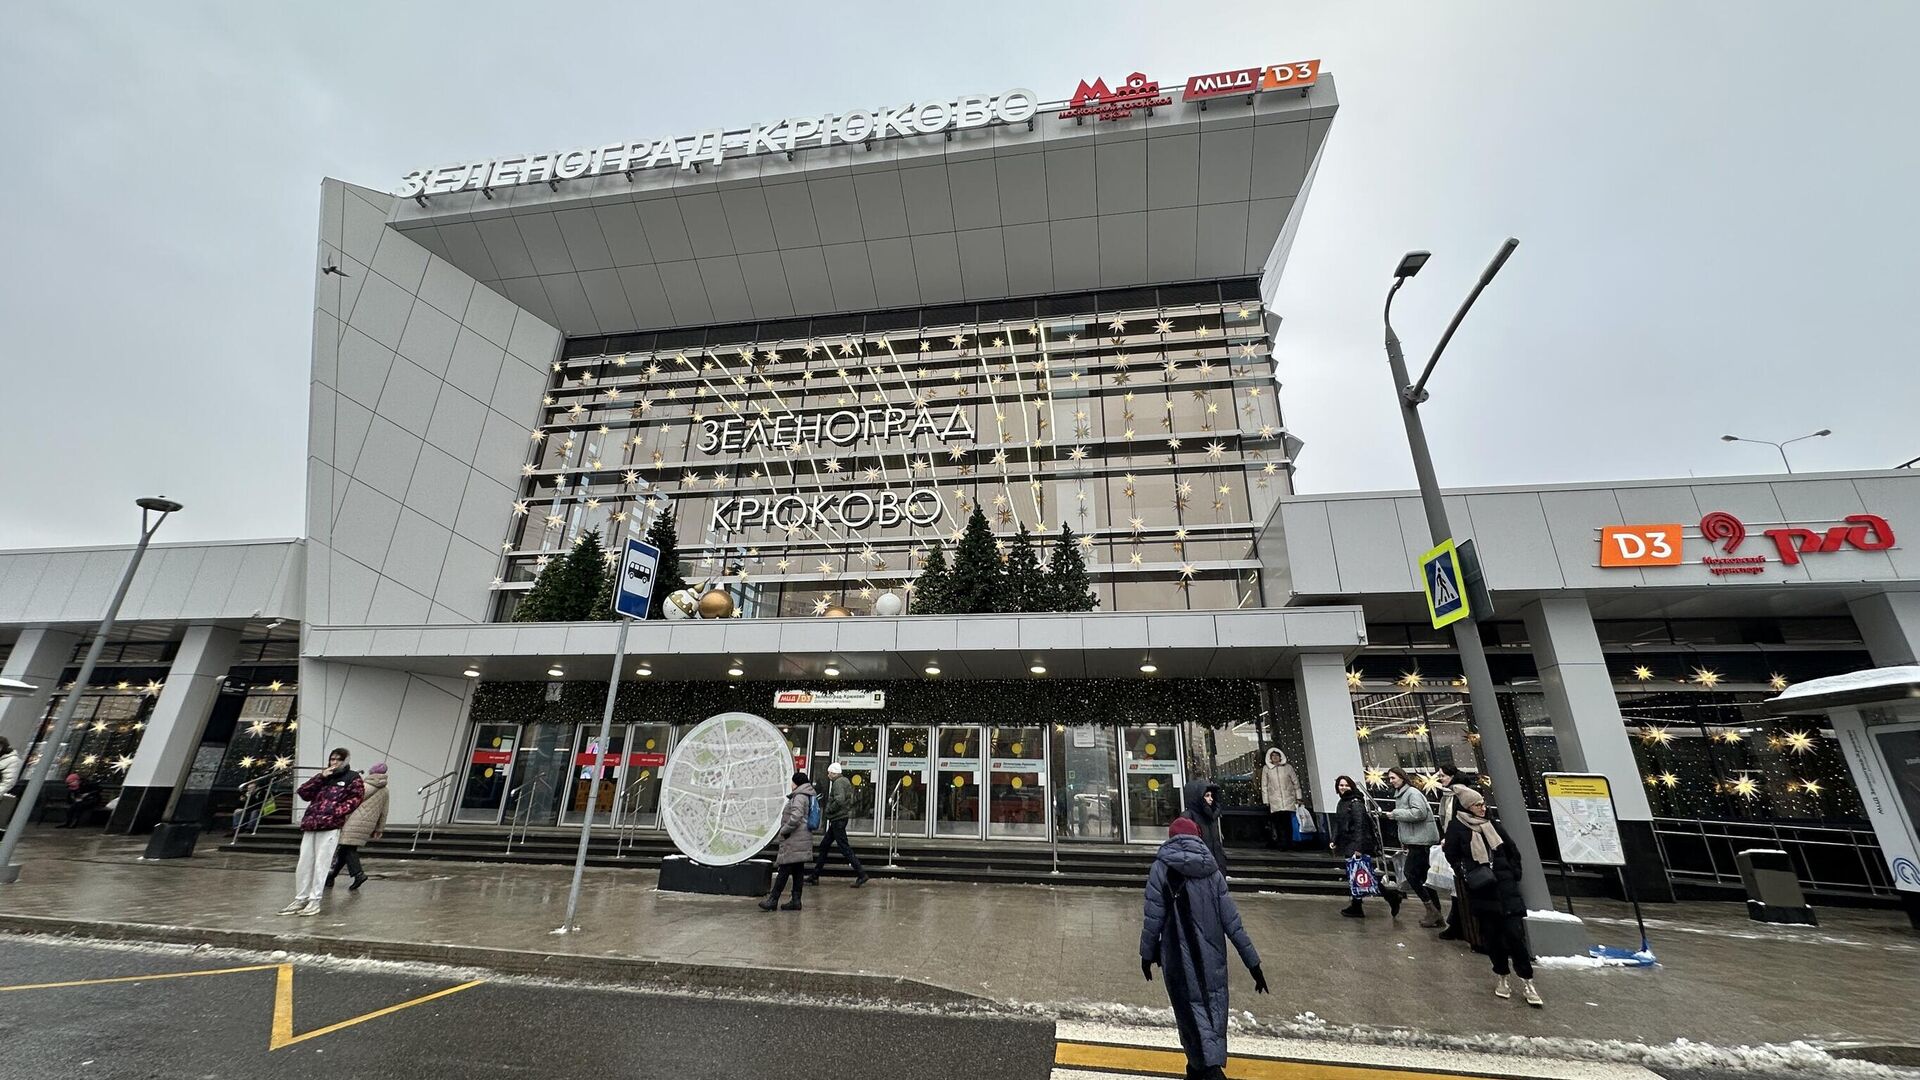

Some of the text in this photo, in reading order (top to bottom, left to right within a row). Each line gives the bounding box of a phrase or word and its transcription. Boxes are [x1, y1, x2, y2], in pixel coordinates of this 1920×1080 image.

[1193, 62, 1312, 92] МЦД D3
[696, 403, 976, 452] ЗЕЛЕНОГРАД
[710, 490, 943, 533] КРЮКОВО
[1612, 531, 1673, 560] D3
